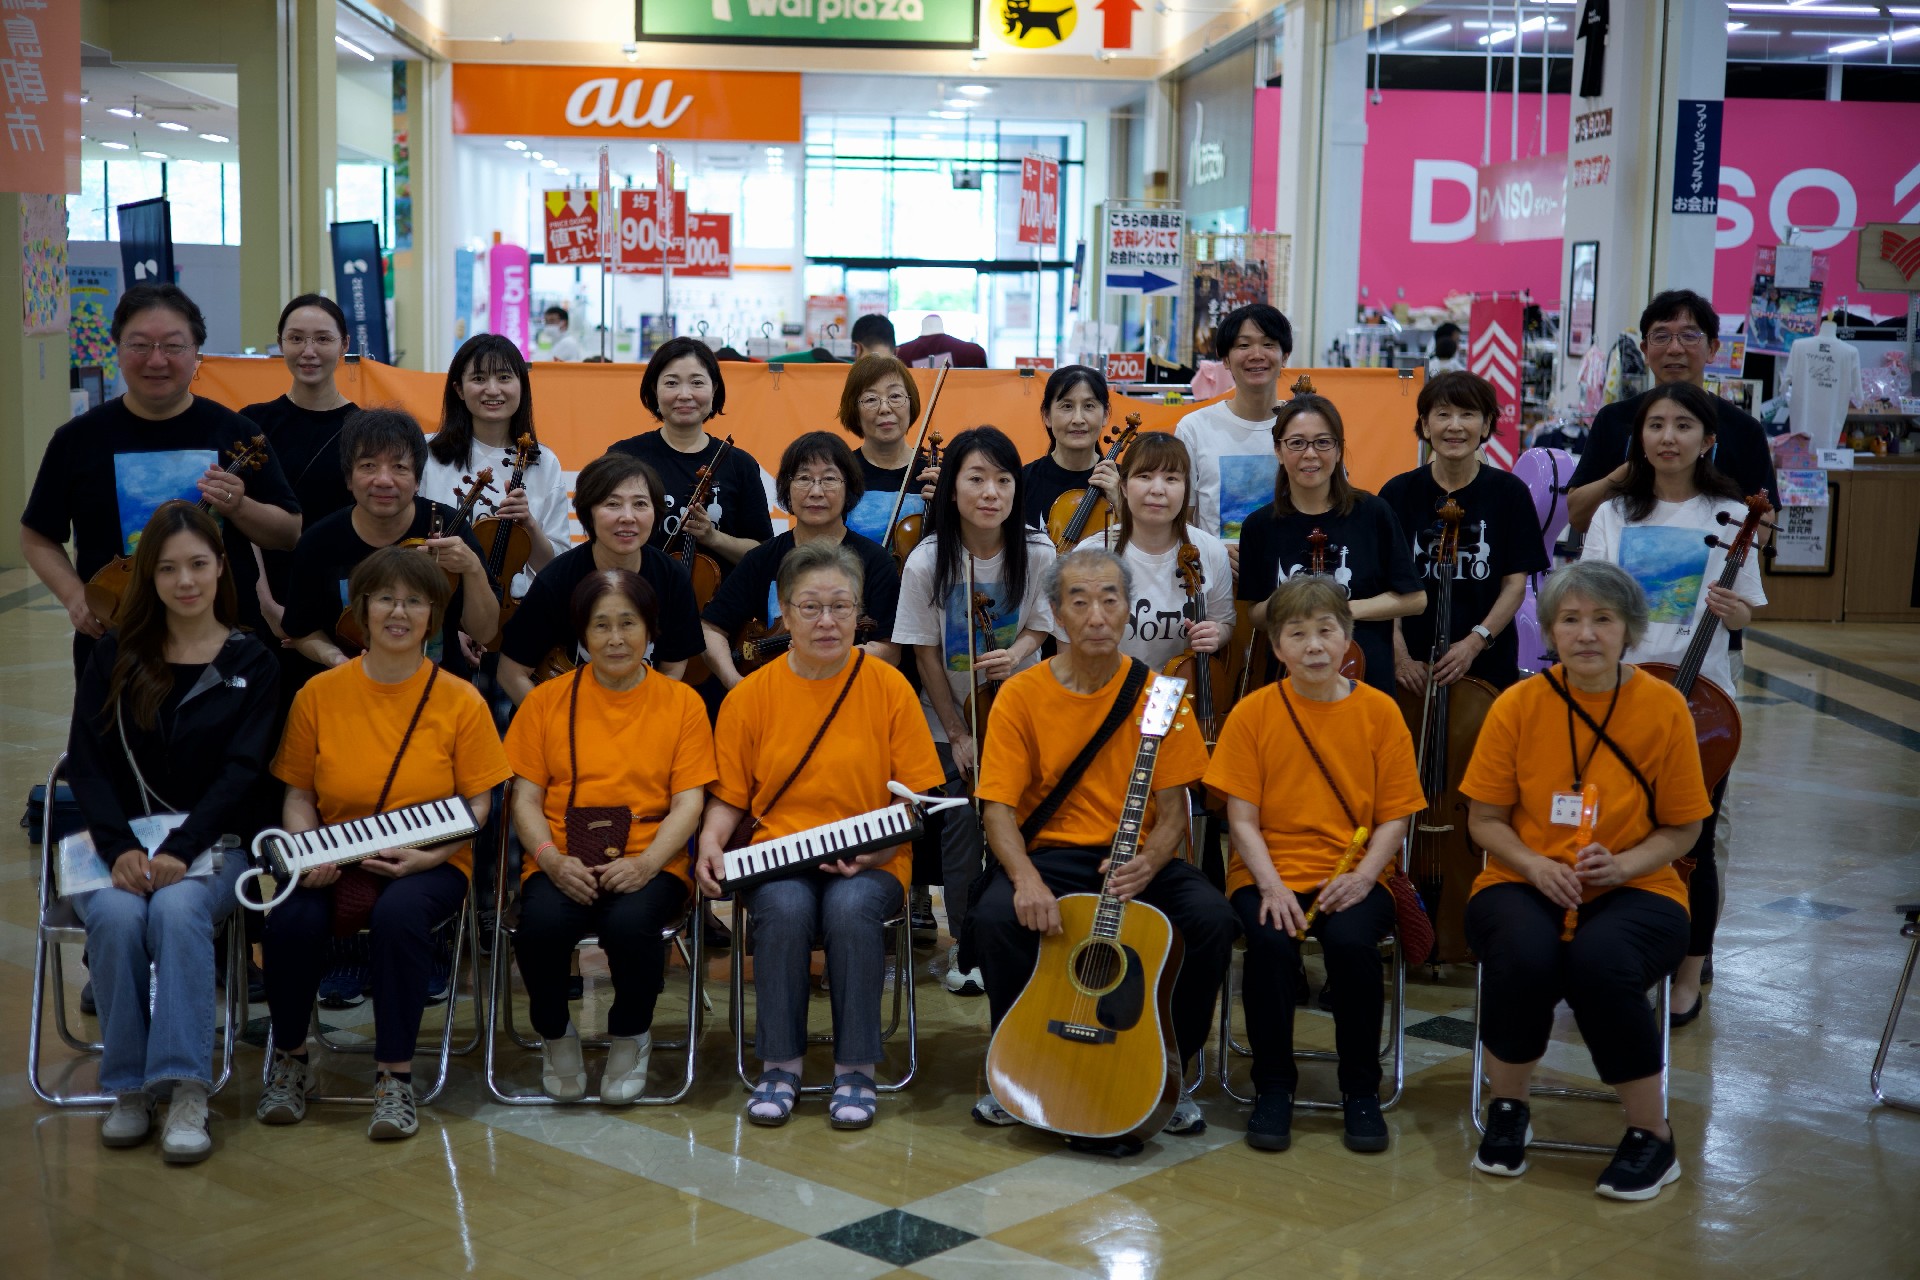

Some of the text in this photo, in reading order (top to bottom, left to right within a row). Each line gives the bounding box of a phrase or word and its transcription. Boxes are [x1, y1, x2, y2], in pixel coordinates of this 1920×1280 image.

[565, 78, 694, 128] au
[1690, 103, 1707, 194] ファッションプラザ
[1479, 181, 1533, 223] DAISO
[1674, 196, 1716, 213] お会計
[1111, 213, 1181, 229] こちらの商品は
[1113, 230, 1178, 249] 衣料レジにて
[1110, 251, 1181, 266] お会計になります
[502, 265, 524, 304] UQ
